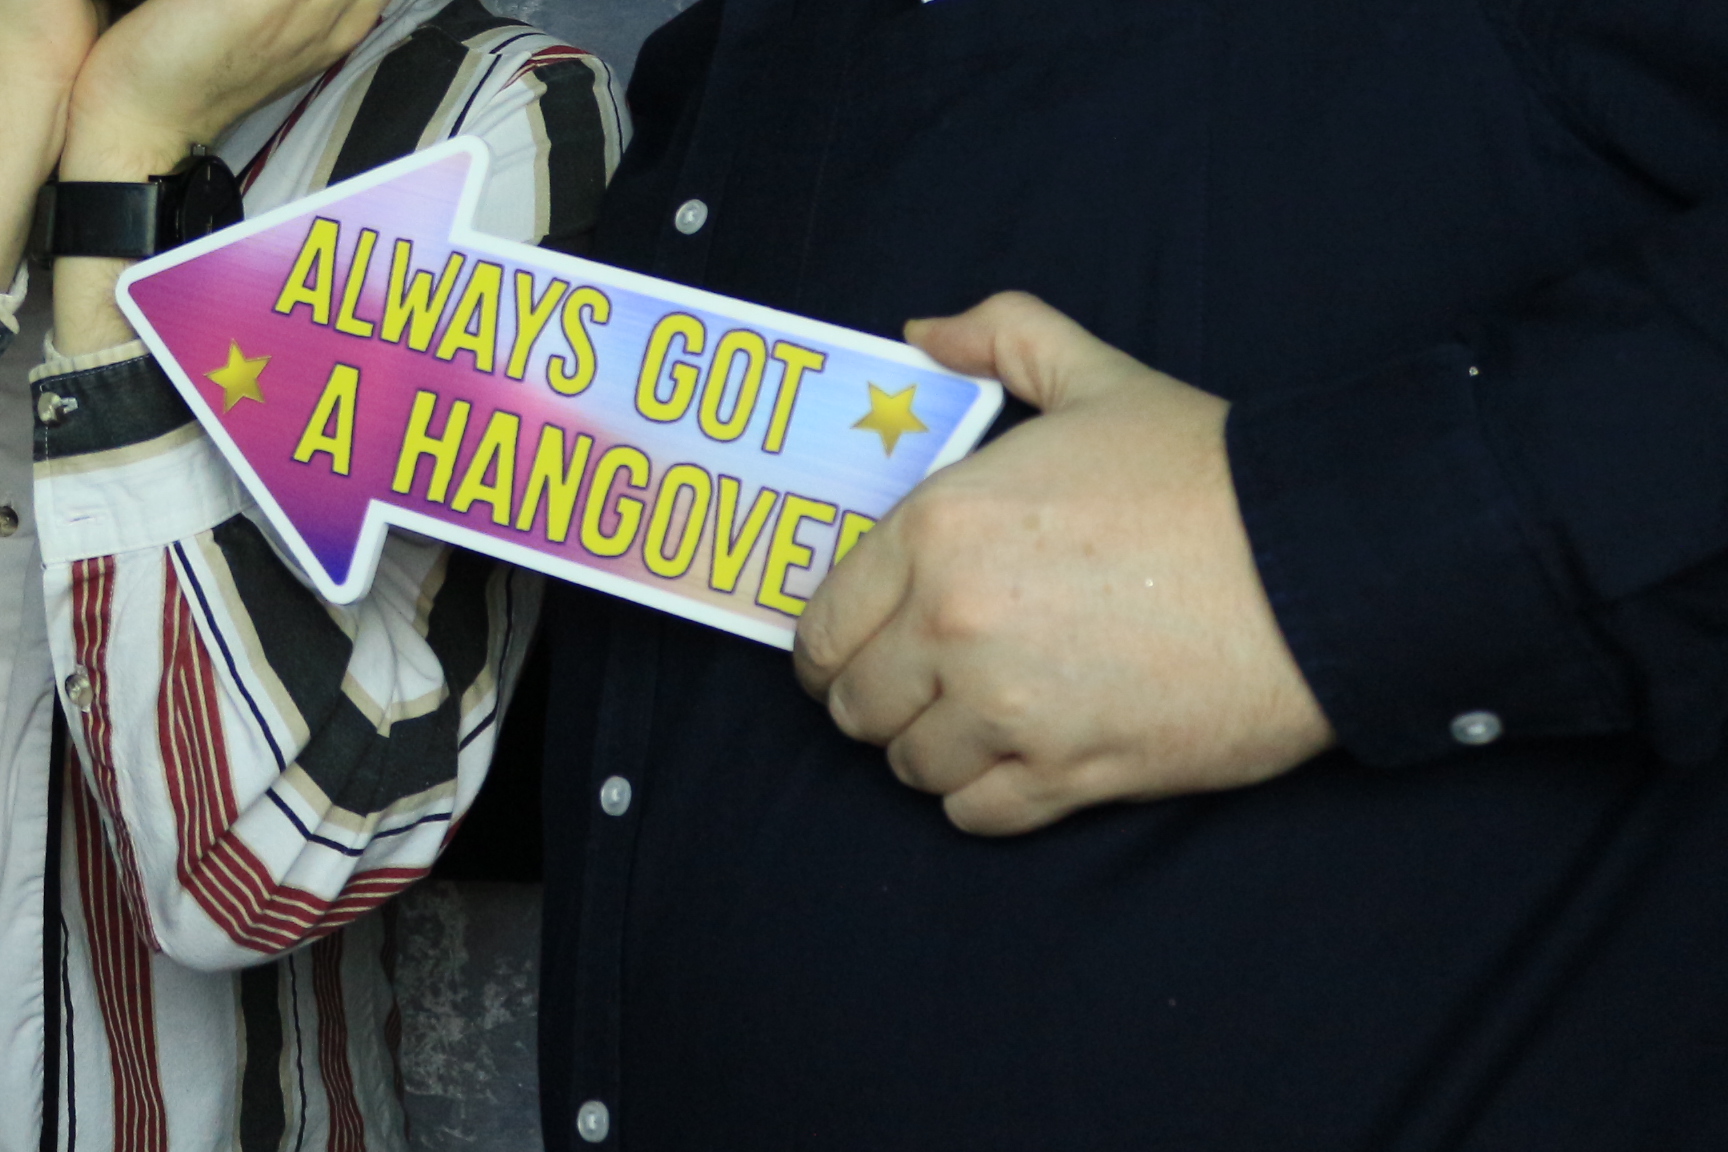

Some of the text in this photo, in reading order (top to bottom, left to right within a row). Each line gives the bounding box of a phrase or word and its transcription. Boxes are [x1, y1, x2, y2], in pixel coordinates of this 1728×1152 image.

[274, 217, 827, 454] ALWAYS GOT
[292, 363, 359, 477] A
